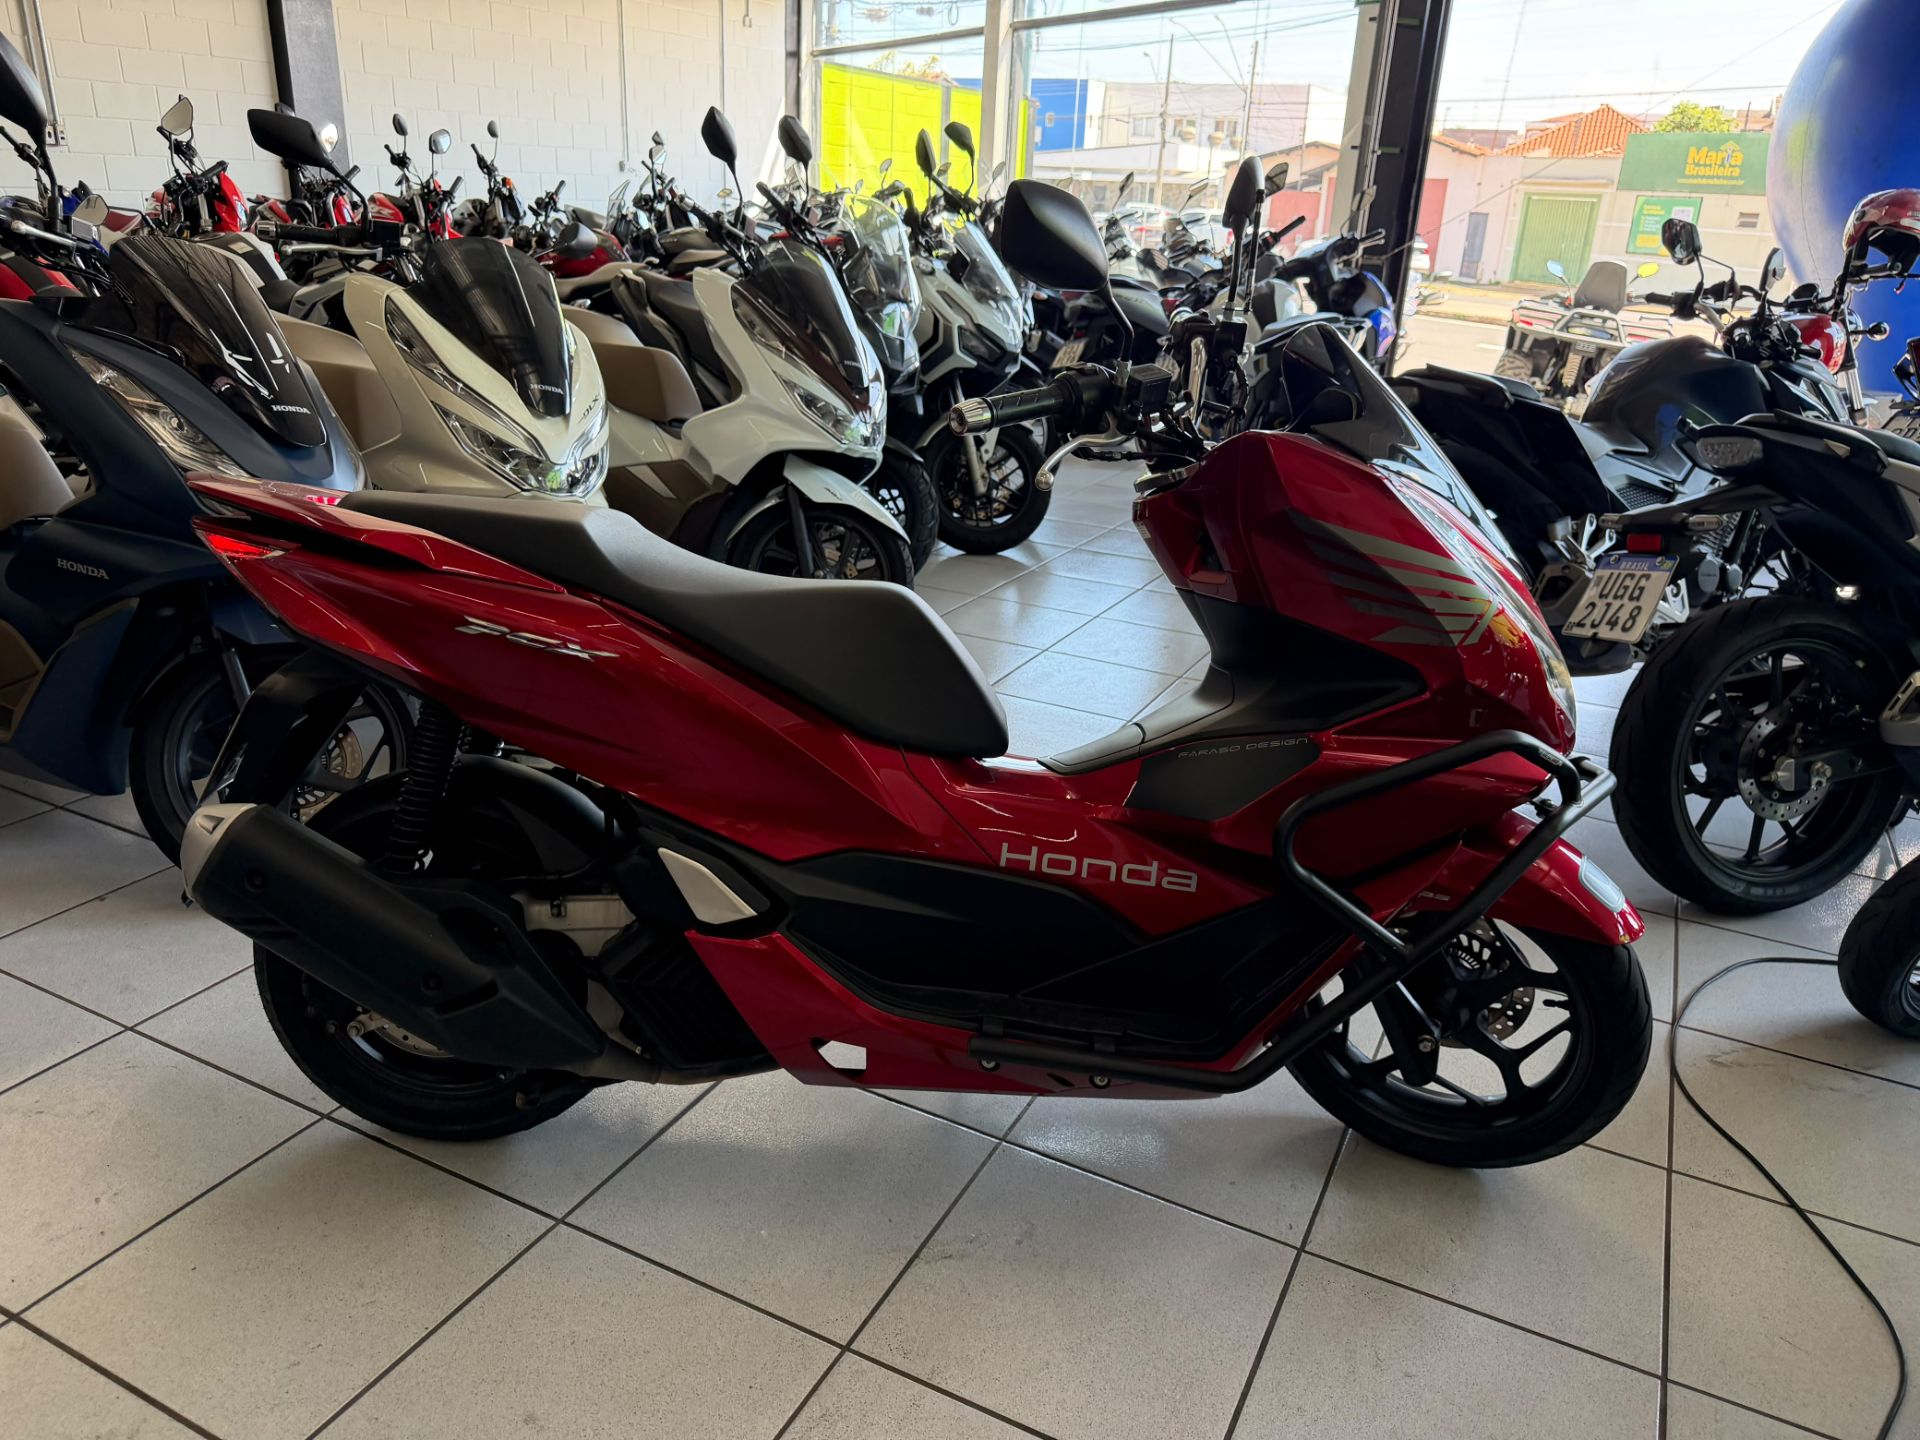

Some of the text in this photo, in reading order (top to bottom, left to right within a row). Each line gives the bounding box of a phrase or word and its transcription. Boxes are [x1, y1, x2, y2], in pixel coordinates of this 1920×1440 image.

[1687, 142, 1744, 166] Maria
[1684, 164, 1740, 177] Brasileira
[530, 383, 564, 395] HONDA
[271, 404, 311, 415] HONDA
[56, 557, 110, 581] HONDA
[1619, 561, 1650, 571] BRASIL
[1598, 572, 1652, 602] UGG
[1573, 601, 1643, 633] 2J48
[454, 615, 621, 663] PCX
[999, 842, 1198, 893] Honda
